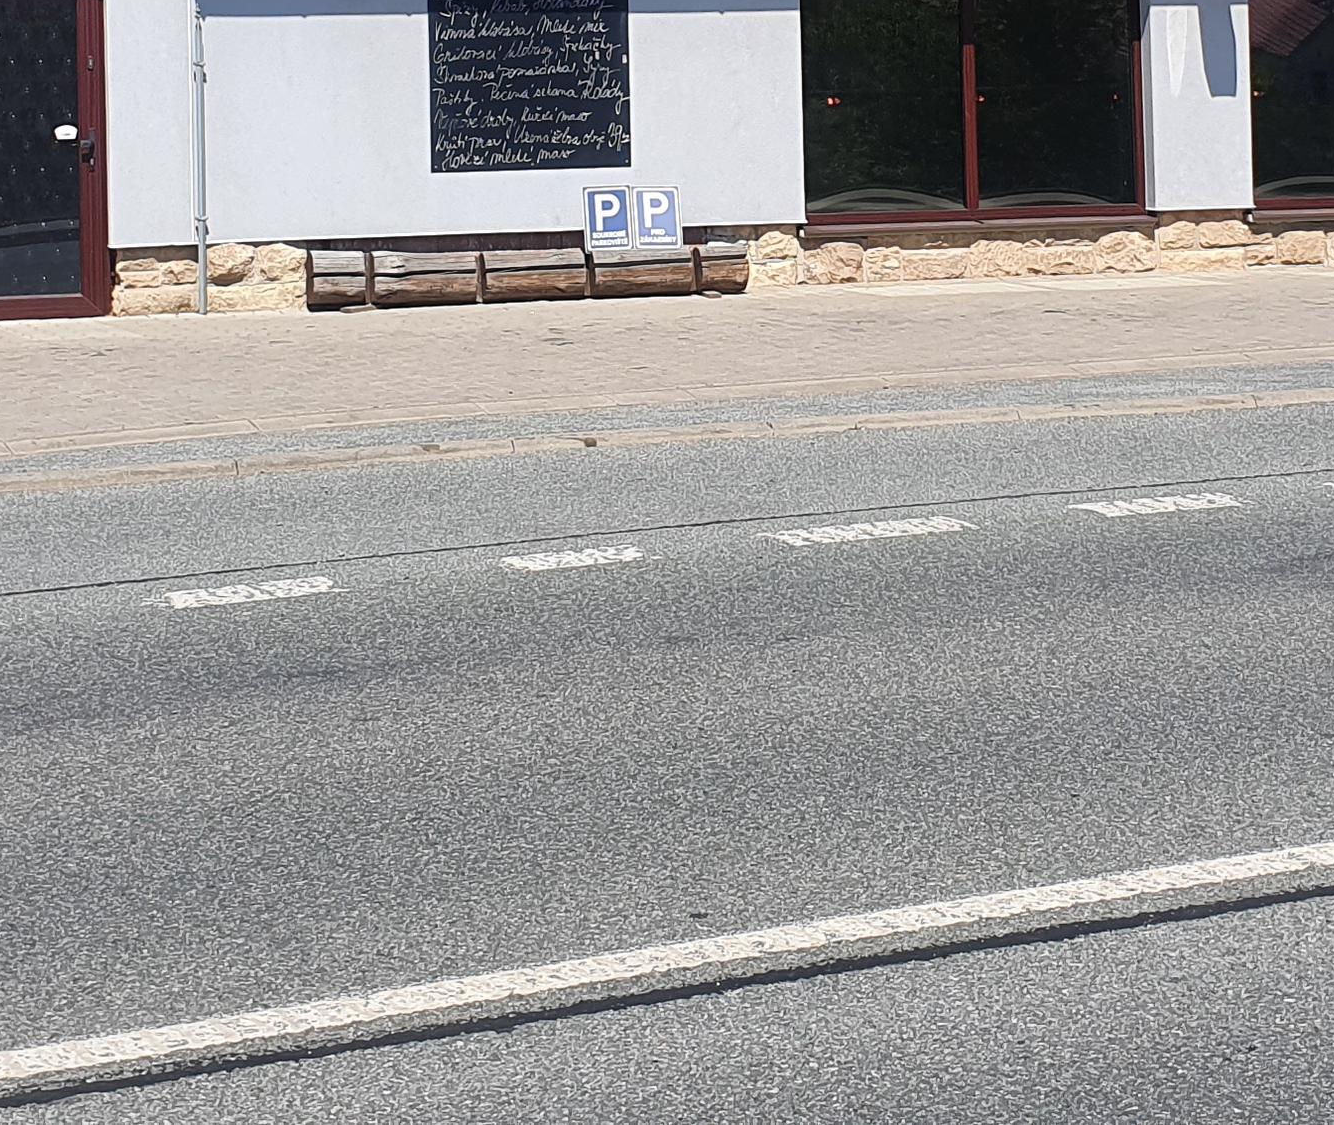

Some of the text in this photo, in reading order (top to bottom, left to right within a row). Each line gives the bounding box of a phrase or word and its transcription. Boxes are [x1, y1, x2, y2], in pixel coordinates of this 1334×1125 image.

[555, 109, 593, 123] maso
[536, 149, 576, 163] maso
[594, 193, 621, 231] P
[642, 192, 669, 228] P
